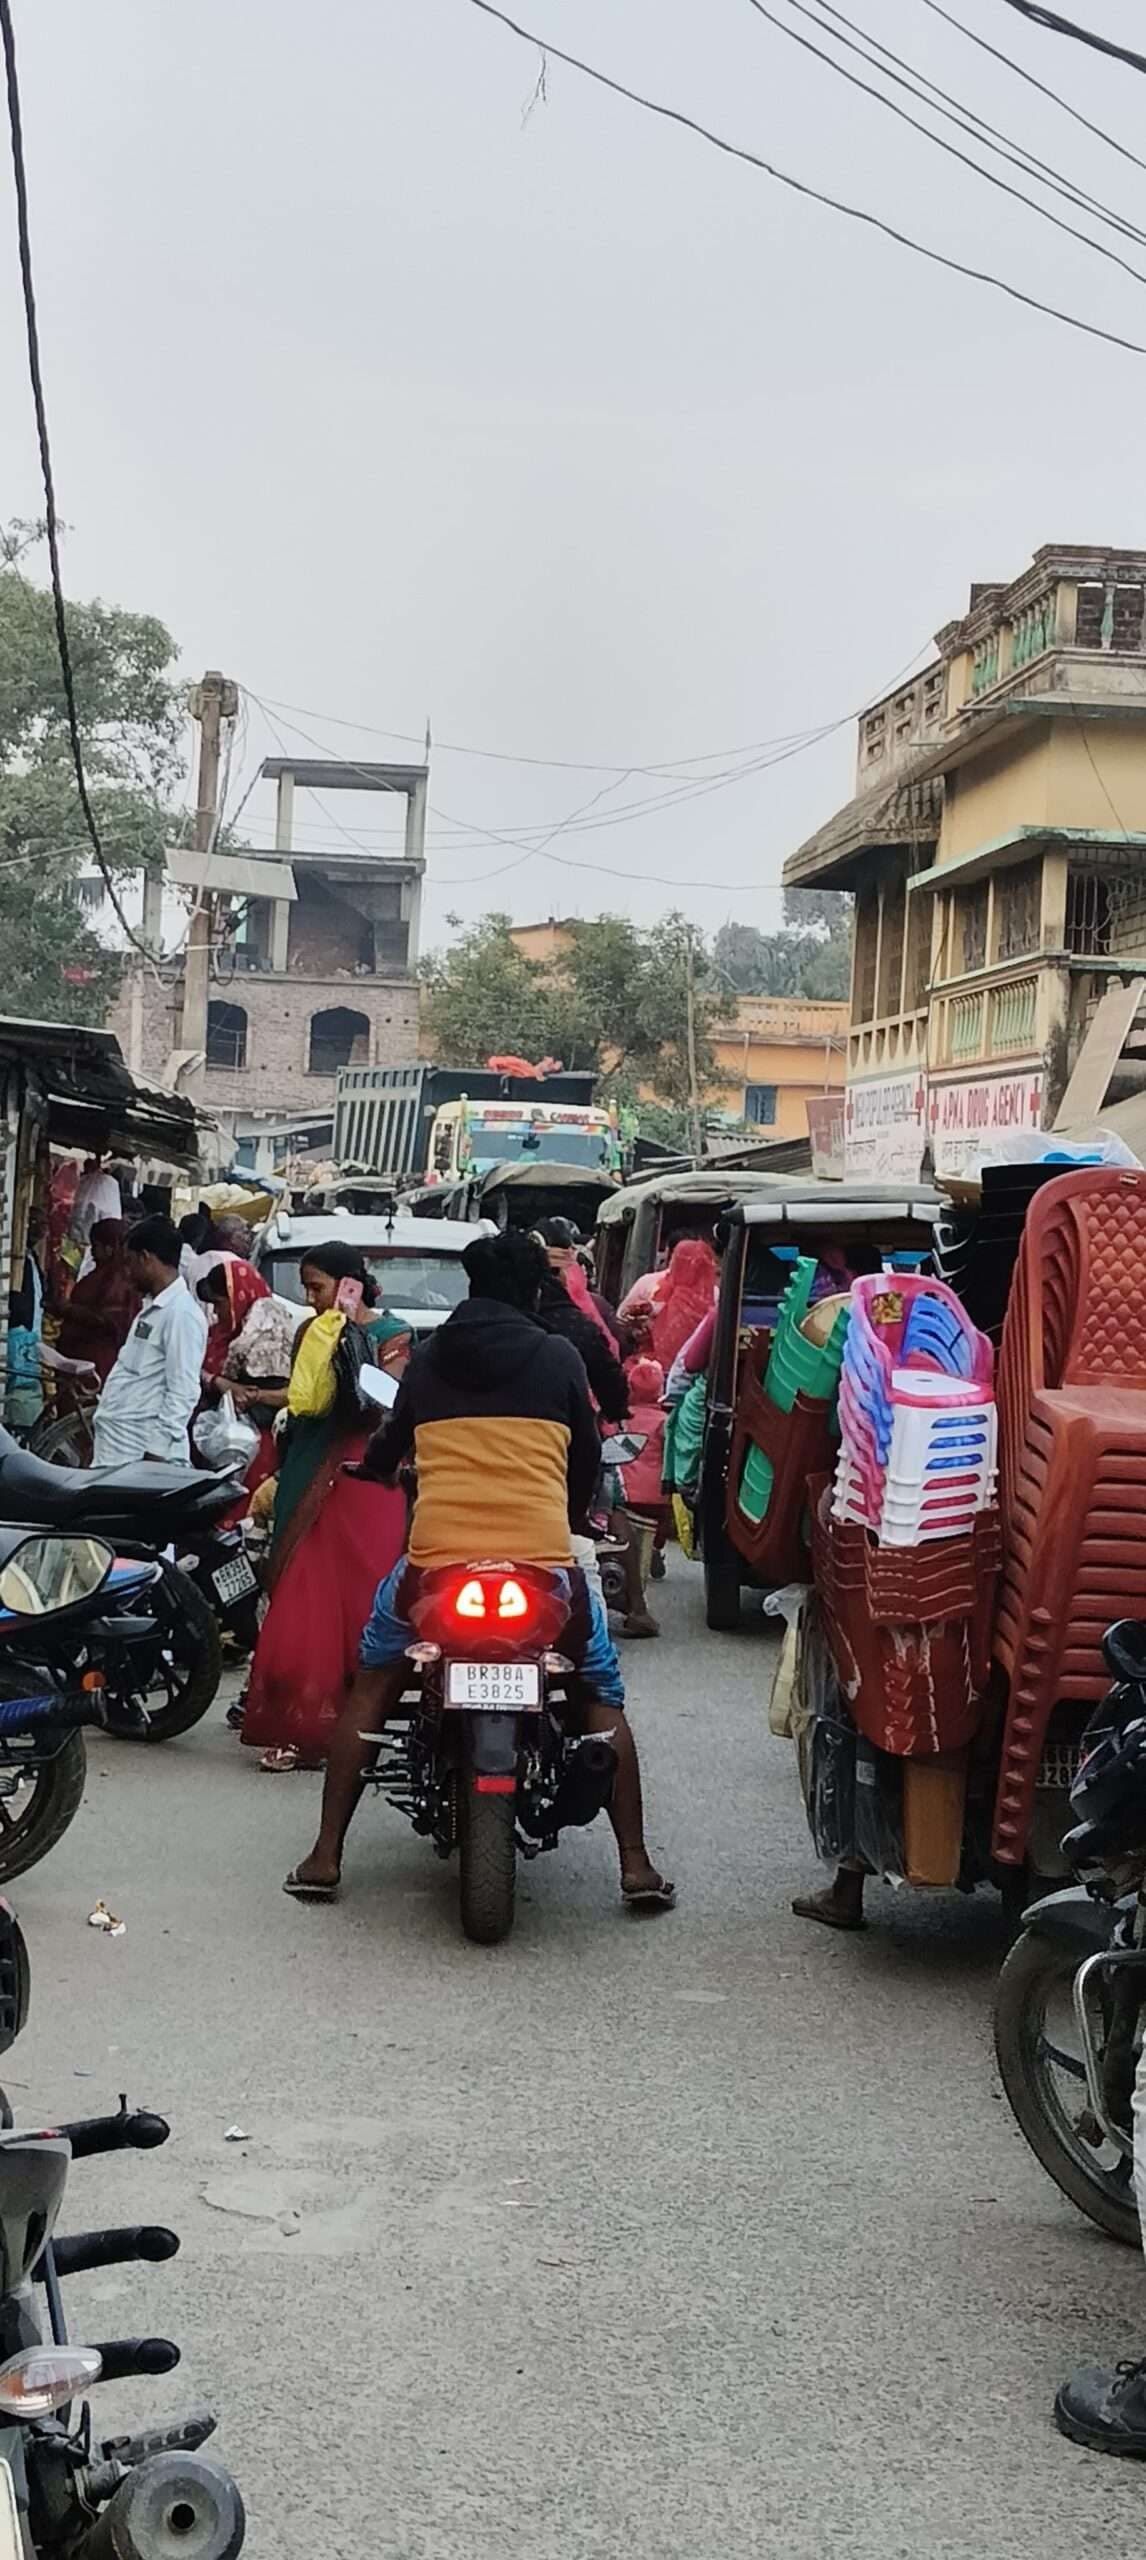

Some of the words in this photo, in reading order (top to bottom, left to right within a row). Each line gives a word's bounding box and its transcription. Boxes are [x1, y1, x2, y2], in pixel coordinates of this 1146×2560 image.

[967, 1087, 989, 1128] DRUG
[992, 1083, 1024, 1127] AGENCY
[467, 1666, 524, 1681] BR38A
[468, 1684, 524, 1700] E3825
